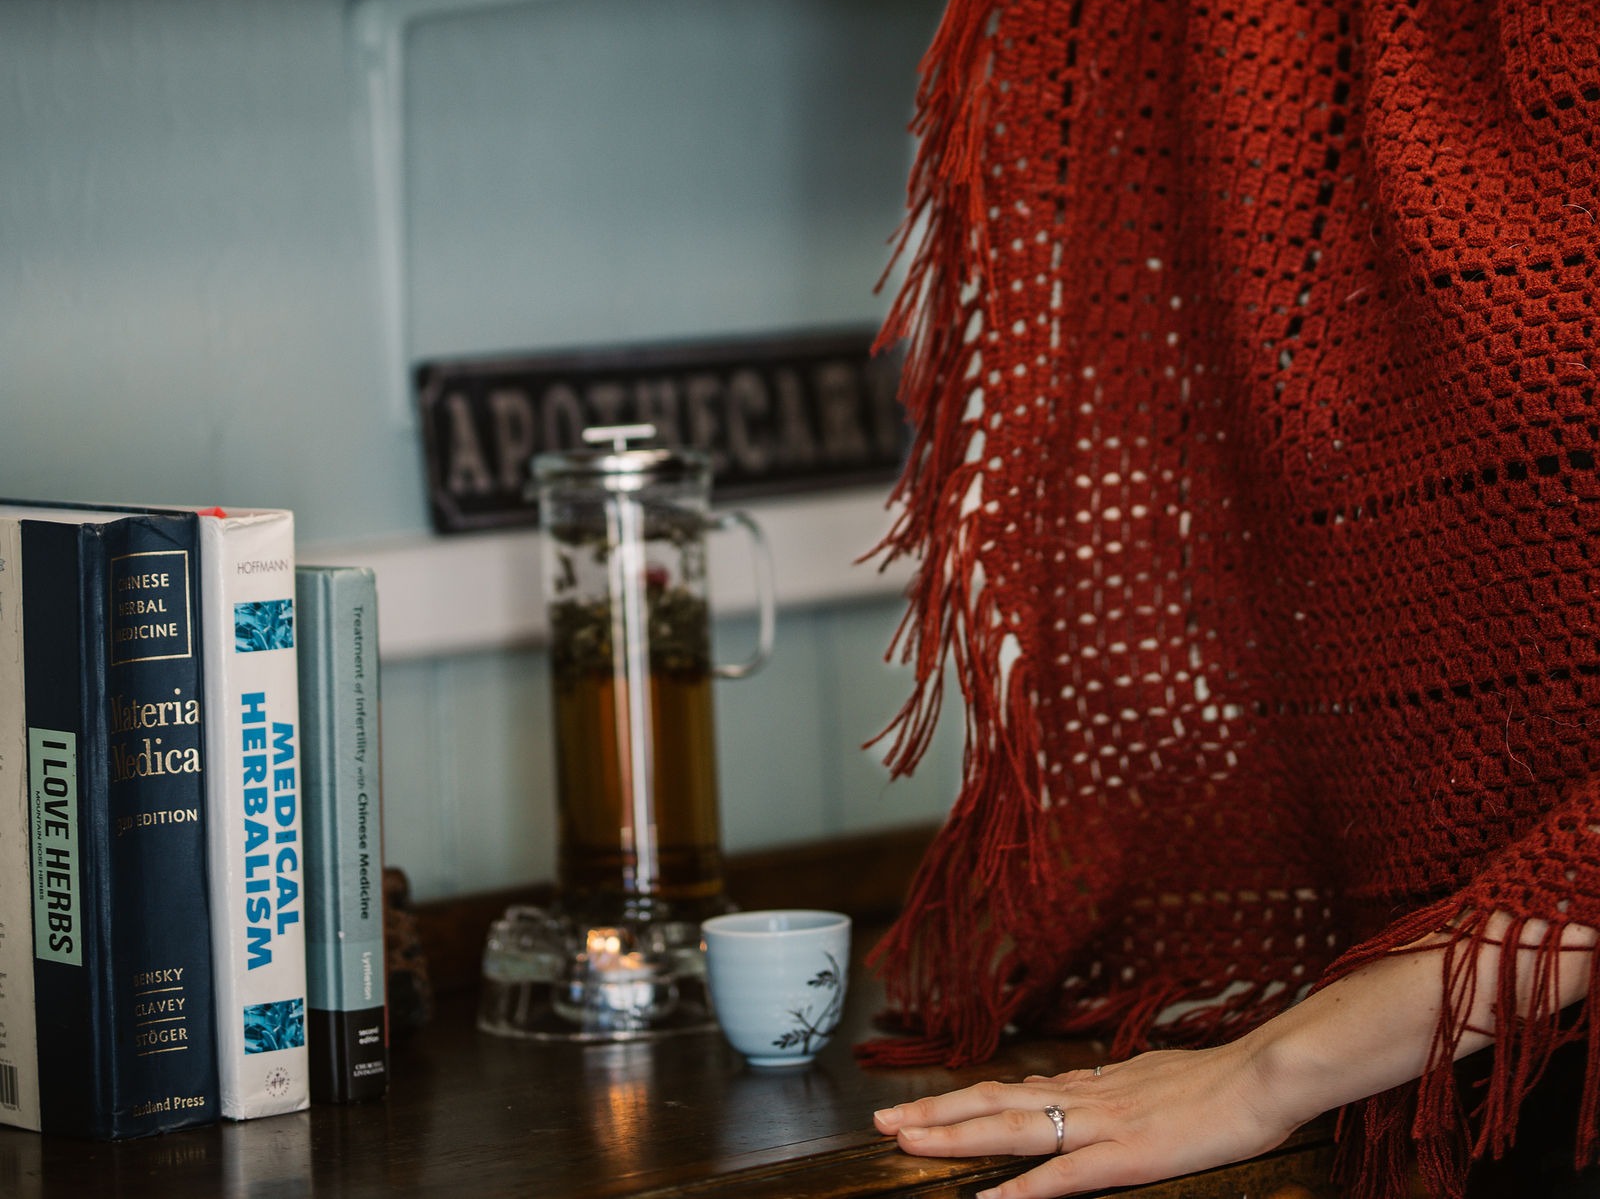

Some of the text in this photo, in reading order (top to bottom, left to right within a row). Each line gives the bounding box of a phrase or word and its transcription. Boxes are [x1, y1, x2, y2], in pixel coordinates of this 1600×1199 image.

[237, 559, 288, 575] HOFFMANN
[119, 573, 170, 592] CHINESE
[119, 598, 167, 616] HERBAL
[116, 622, 178, 641] MEDICINE
[111, 687, 201, 734] Materia
[112, 737, 202, 783] Medica
[353, 605, 371, 920] Treatment of Infertility with Chinese Medicine
[137, 808, 198, 827] EDITION
[241, 692, 272, 970] HERBALISM
[272, 722, 300, 935] MEDICAL
[43, 740, 73, 954] I LOVE HERBS
[134, 968, 183, 987] BENSKY
[135, 998, 185, 1017] CLAVEY
[136, 1028, 188, 1048] STÖGER
[174, 1096, 205, 1110] Press
